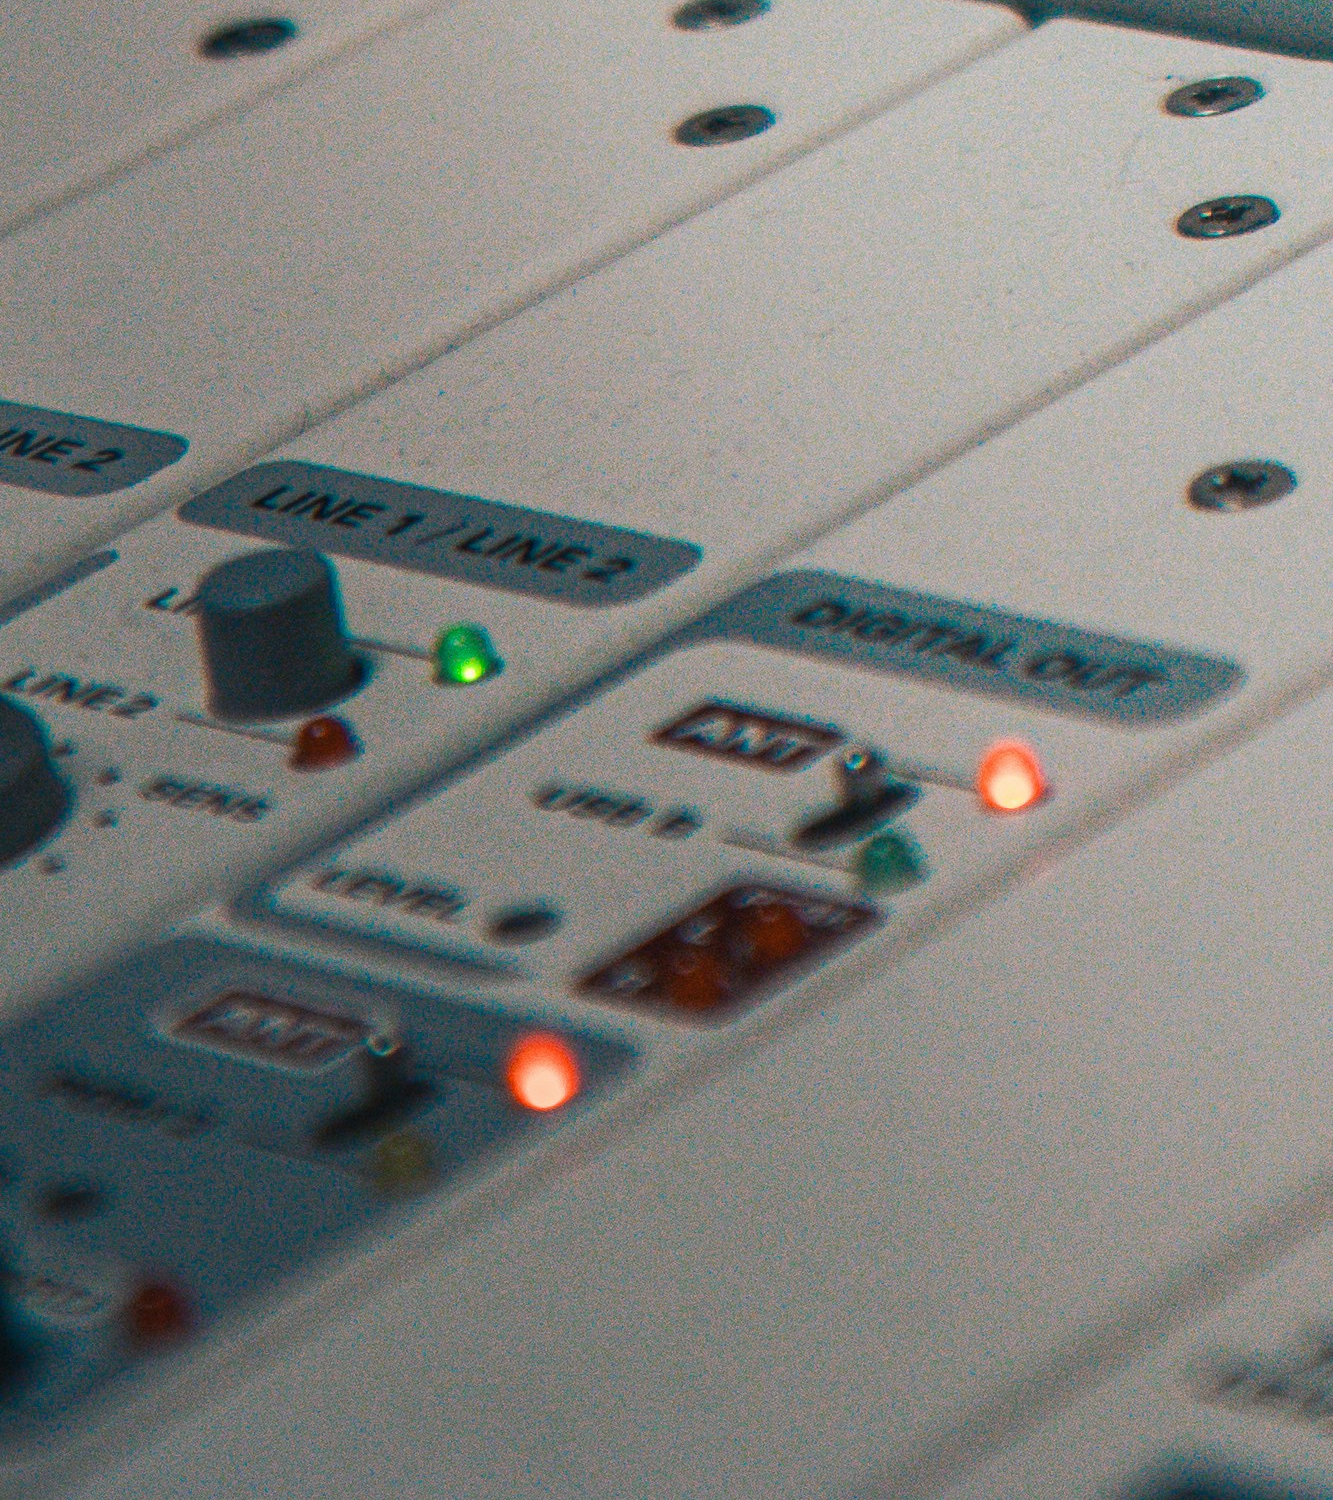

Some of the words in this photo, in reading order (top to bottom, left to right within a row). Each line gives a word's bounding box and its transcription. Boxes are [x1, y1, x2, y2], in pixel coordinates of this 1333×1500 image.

[68, 446, 126, 474] 2
[251, 483, 392, 530] LINE
[386, 512, 426, 537] 1
[453, 524, 597, 574] LINE
[576, 556, 636, 584] 2
[790, 598, 1016, 671] DIGITAL
[1023, 650, 1166, 701] OUT
[1, 666, 124, 712] LINE
